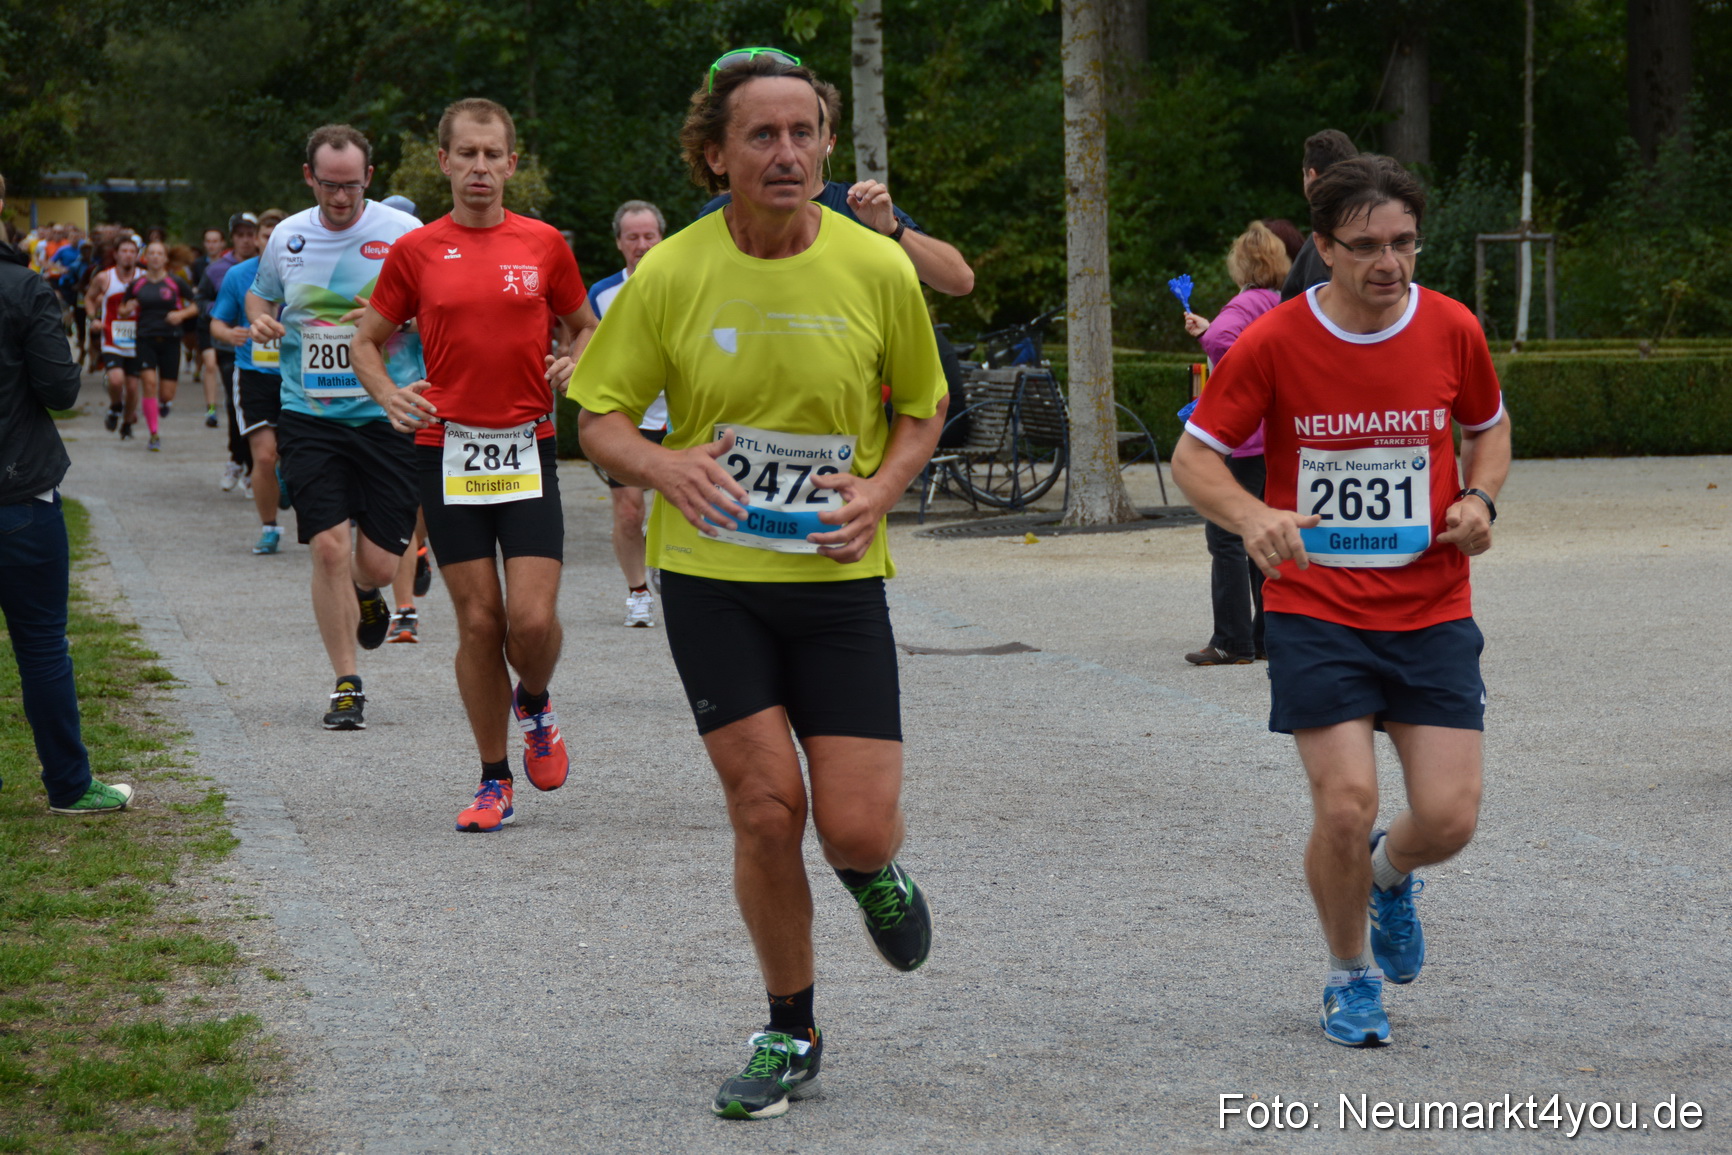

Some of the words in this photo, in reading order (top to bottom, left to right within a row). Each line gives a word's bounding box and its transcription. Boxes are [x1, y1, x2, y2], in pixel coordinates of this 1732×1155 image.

[302, 332, 323, 341] PARTL
[323, 332, 354, 341] Neumark
[308, 343, 350, 369] 280
[317, 376, 357, 387] Mathias
[1294, 410, 1430, 436] NEUMARKT
[447, 430, 476, 440] PARTL
[477, 430, 521, 440] Neumarkt
[1373, 438, 1406, 446] STARKE
[1406, 437, 1429, 445] STADT
[717, 430, 763, 453] PRTL
[765, 443, 833, 460] Neumarkt
[462, 443, 522, 472] 284
[1302, 459, 1343, 472] PARTL
[1345, 459, 1407, 471] Neumarkt
[465, 479, 520, 493] Christian
[1309, 475, 1413, 521] 2631
[747, 512, 798, 535] Claus
[1329, 532, 1398, 550] Gerhard
